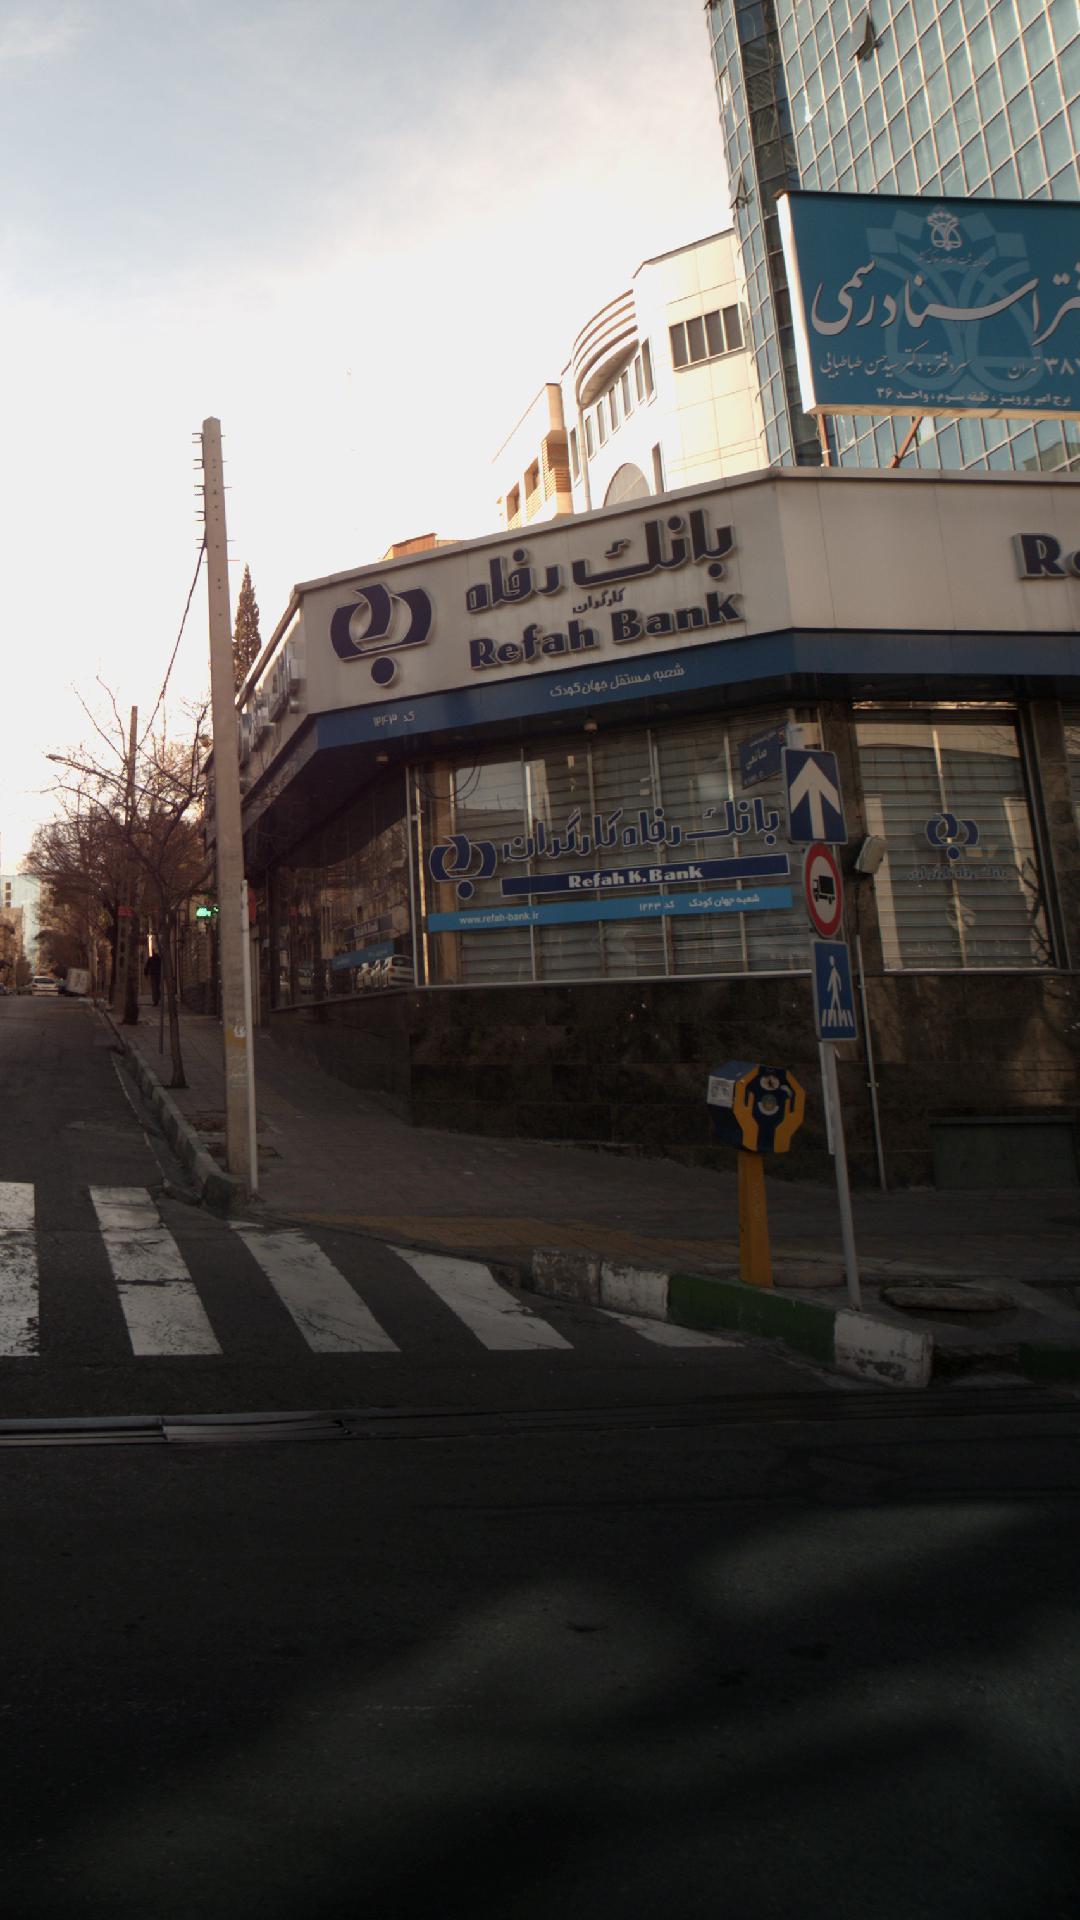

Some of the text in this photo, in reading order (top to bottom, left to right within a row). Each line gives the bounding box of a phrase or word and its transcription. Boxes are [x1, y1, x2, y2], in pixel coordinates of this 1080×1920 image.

[811, 259, 876, 336] رسمی
[880, 273, 1040, 332] اسناد
[1007, 355, 1041, 380] تهران
[465, 508, 737, 614] بانک رفاه
[572, 587, 626, 615] کارگران
[469, 590, 744, 671] Refah Bank
[550, 663, 685, 698] شعبه مستقل جهان کودک
[402, 710, 416, 723] کد
[502, 797, 780, 864] بانک رفاه کارگران
[567, 872, 625, 889] Refah
[735, 893, 760, 905] شعبه
[459, 911, 540, 924] www.refah-bank.ir
